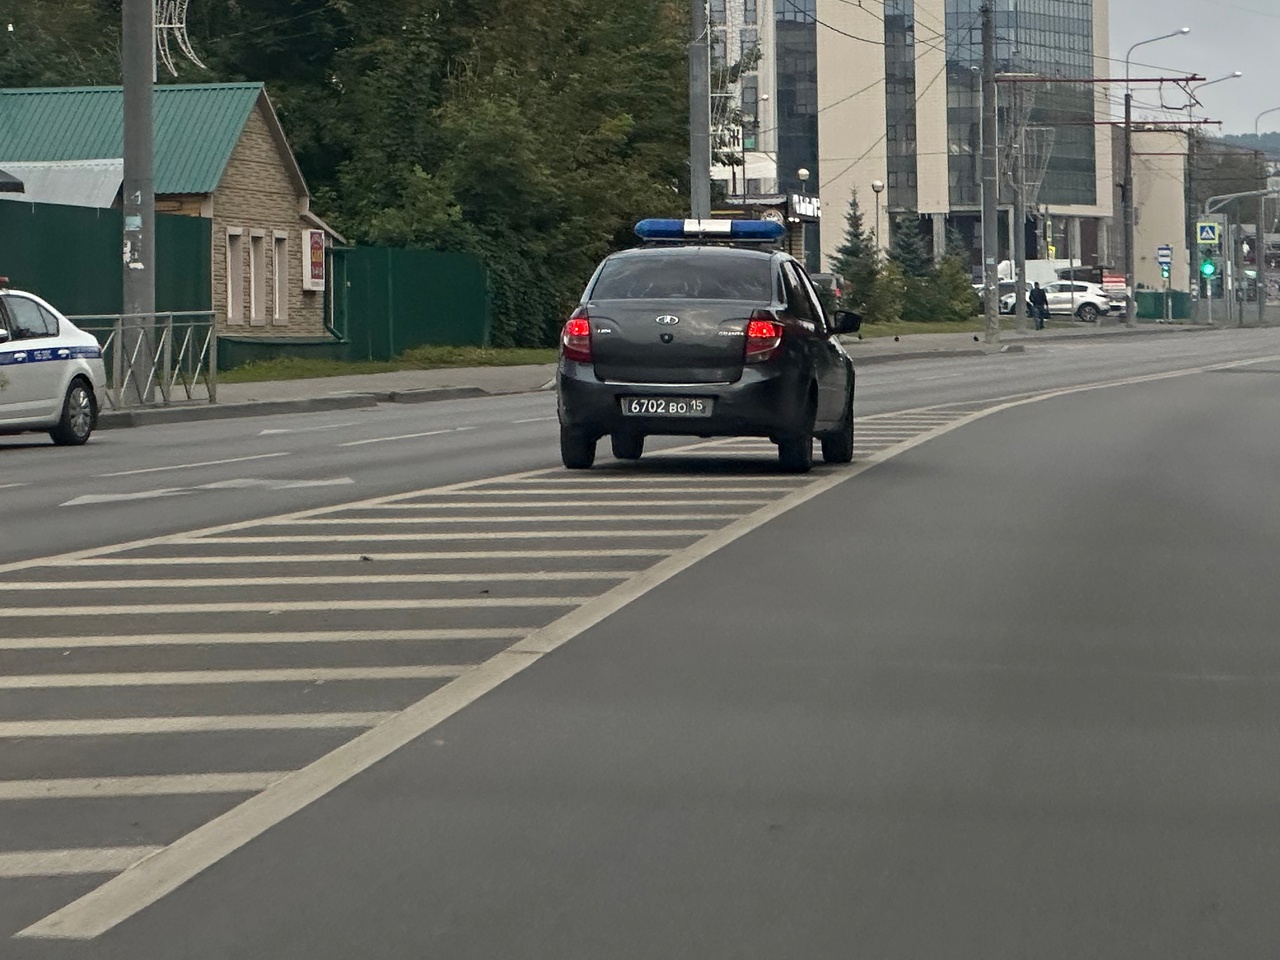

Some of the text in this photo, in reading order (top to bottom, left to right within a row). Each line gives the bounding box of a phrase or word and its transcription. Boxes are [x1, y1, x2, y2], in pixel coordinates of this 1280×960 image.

[631, 399, 703, 413] 6702 ВО 15
